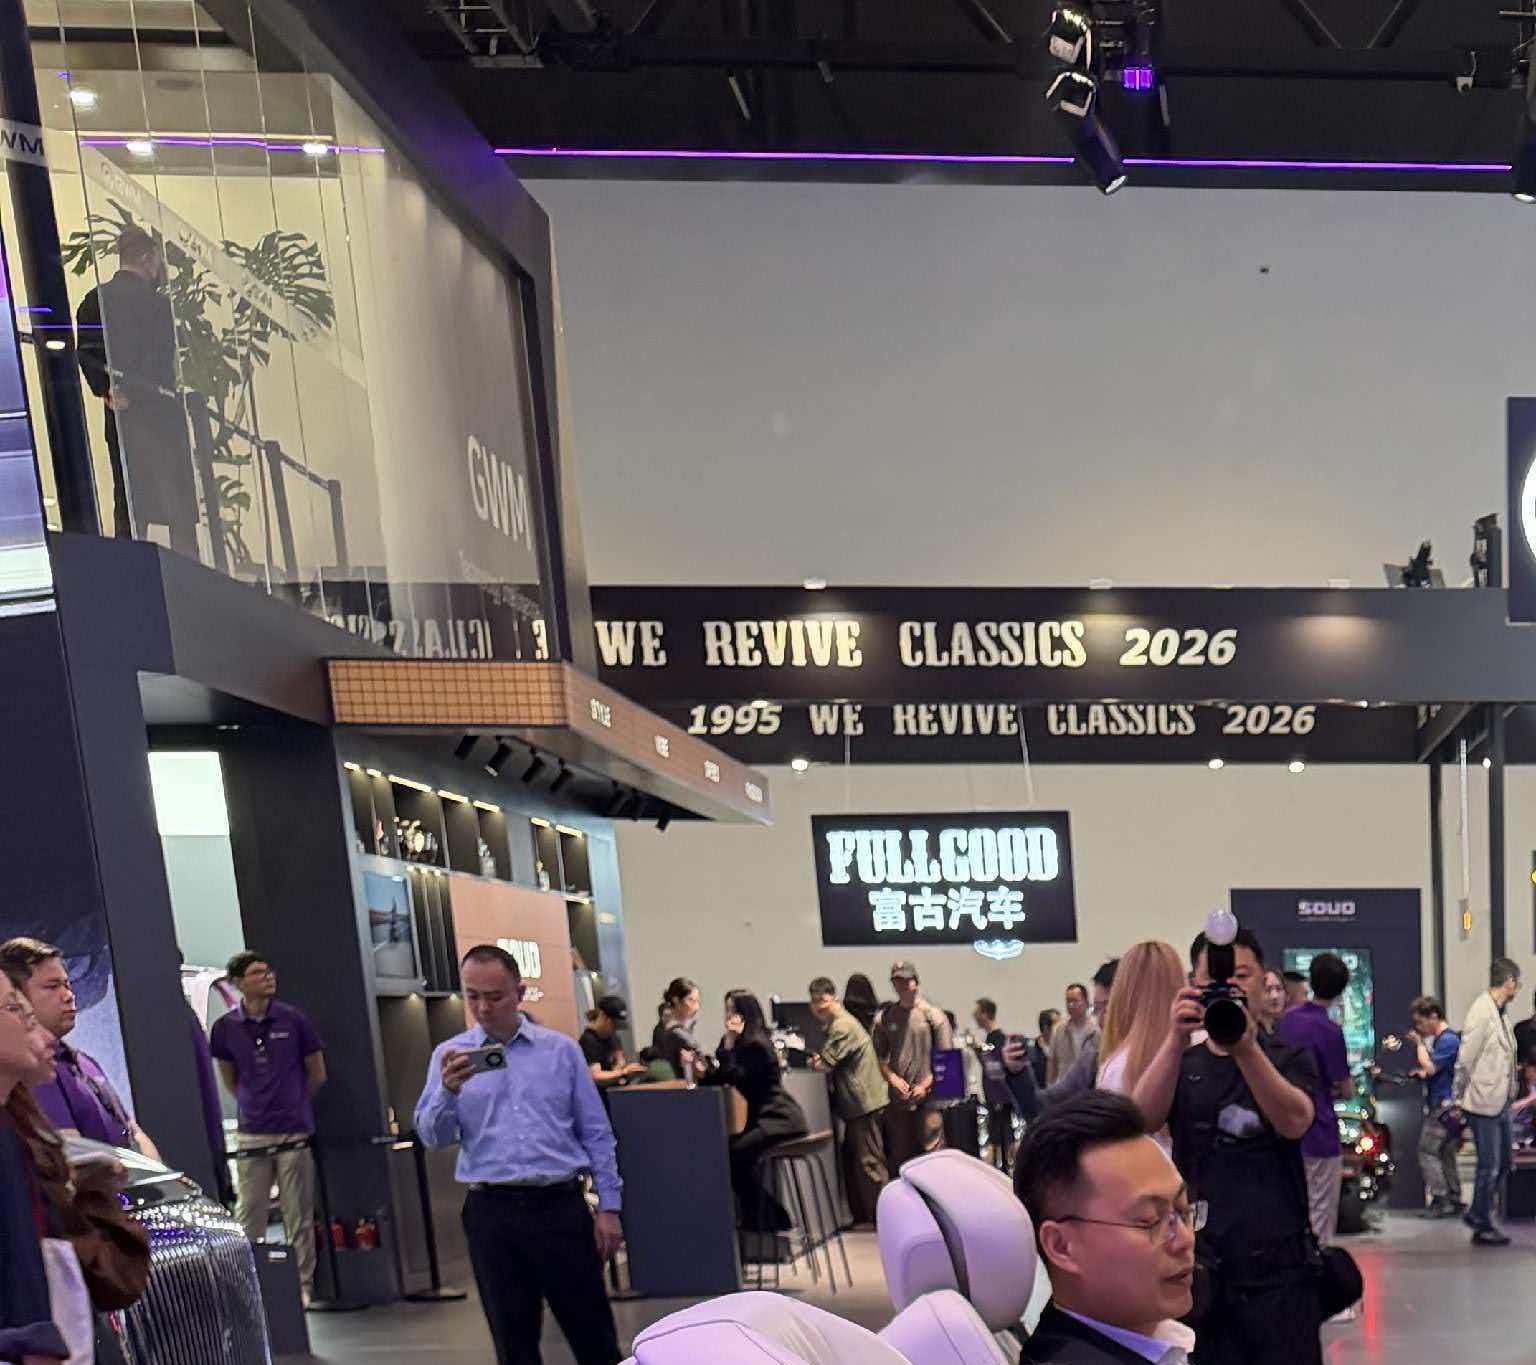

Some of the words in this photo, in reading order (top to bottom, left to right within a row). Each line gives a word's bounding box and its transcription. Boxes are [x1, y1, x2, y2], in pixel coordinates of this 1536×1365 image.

[467, 434, 533, 551] GWM
[594, 620, 668, 668] WE
[703, 620, 863, 668] REVIVE
[899, 620, 1088, 668] CLASSICS
[1118, 628, 1238, 666] 2026
[687, 703, 783, 735] 1995
[809, 703, 865, 736] WE
[892, 703, 1018, 736] REVIVE
[1047, 703, 1197, 736] CLASSICS
[1222, 704, 1317, 735] 2026
[825, 827, 1060, 884] FULLGOOD
[867, 885, 1026, 932] 富古汽车
